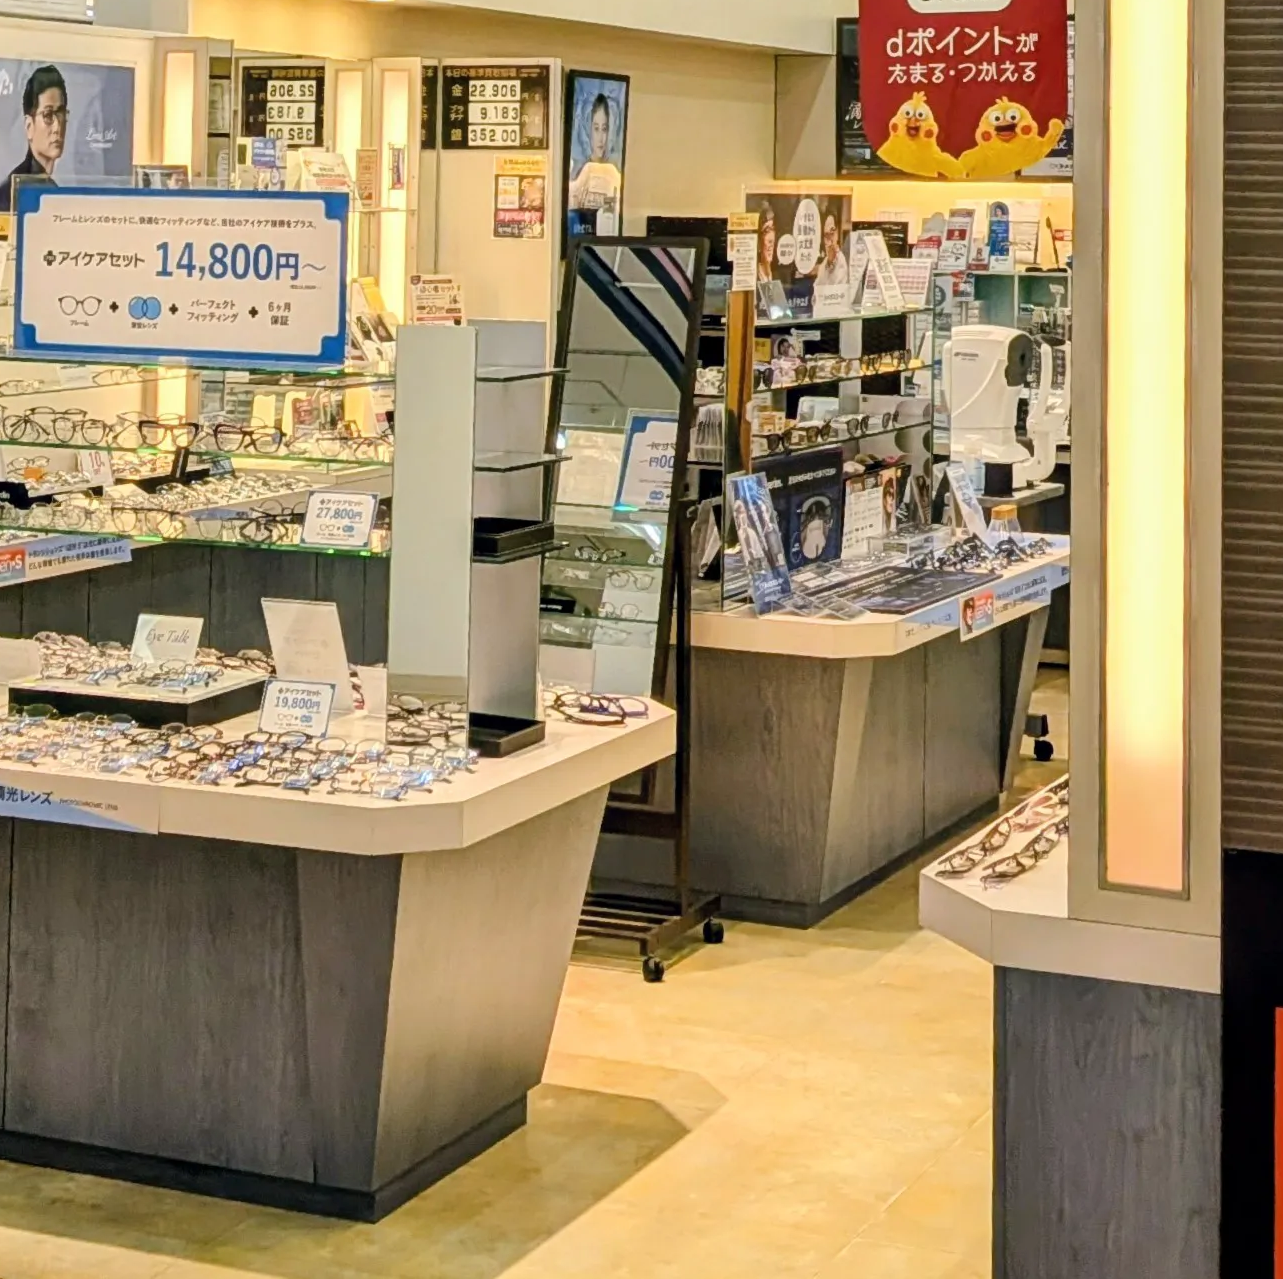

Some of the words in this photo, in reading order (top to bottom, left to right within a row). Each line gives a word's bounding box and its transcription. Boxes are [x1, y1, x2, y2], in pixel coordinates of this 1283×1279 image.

[886, 26, 1038, 57] dポイントが
[887, 62, 1036, 83] たまる・つかえる
[58, 250, 145, 268] アイケアセット
